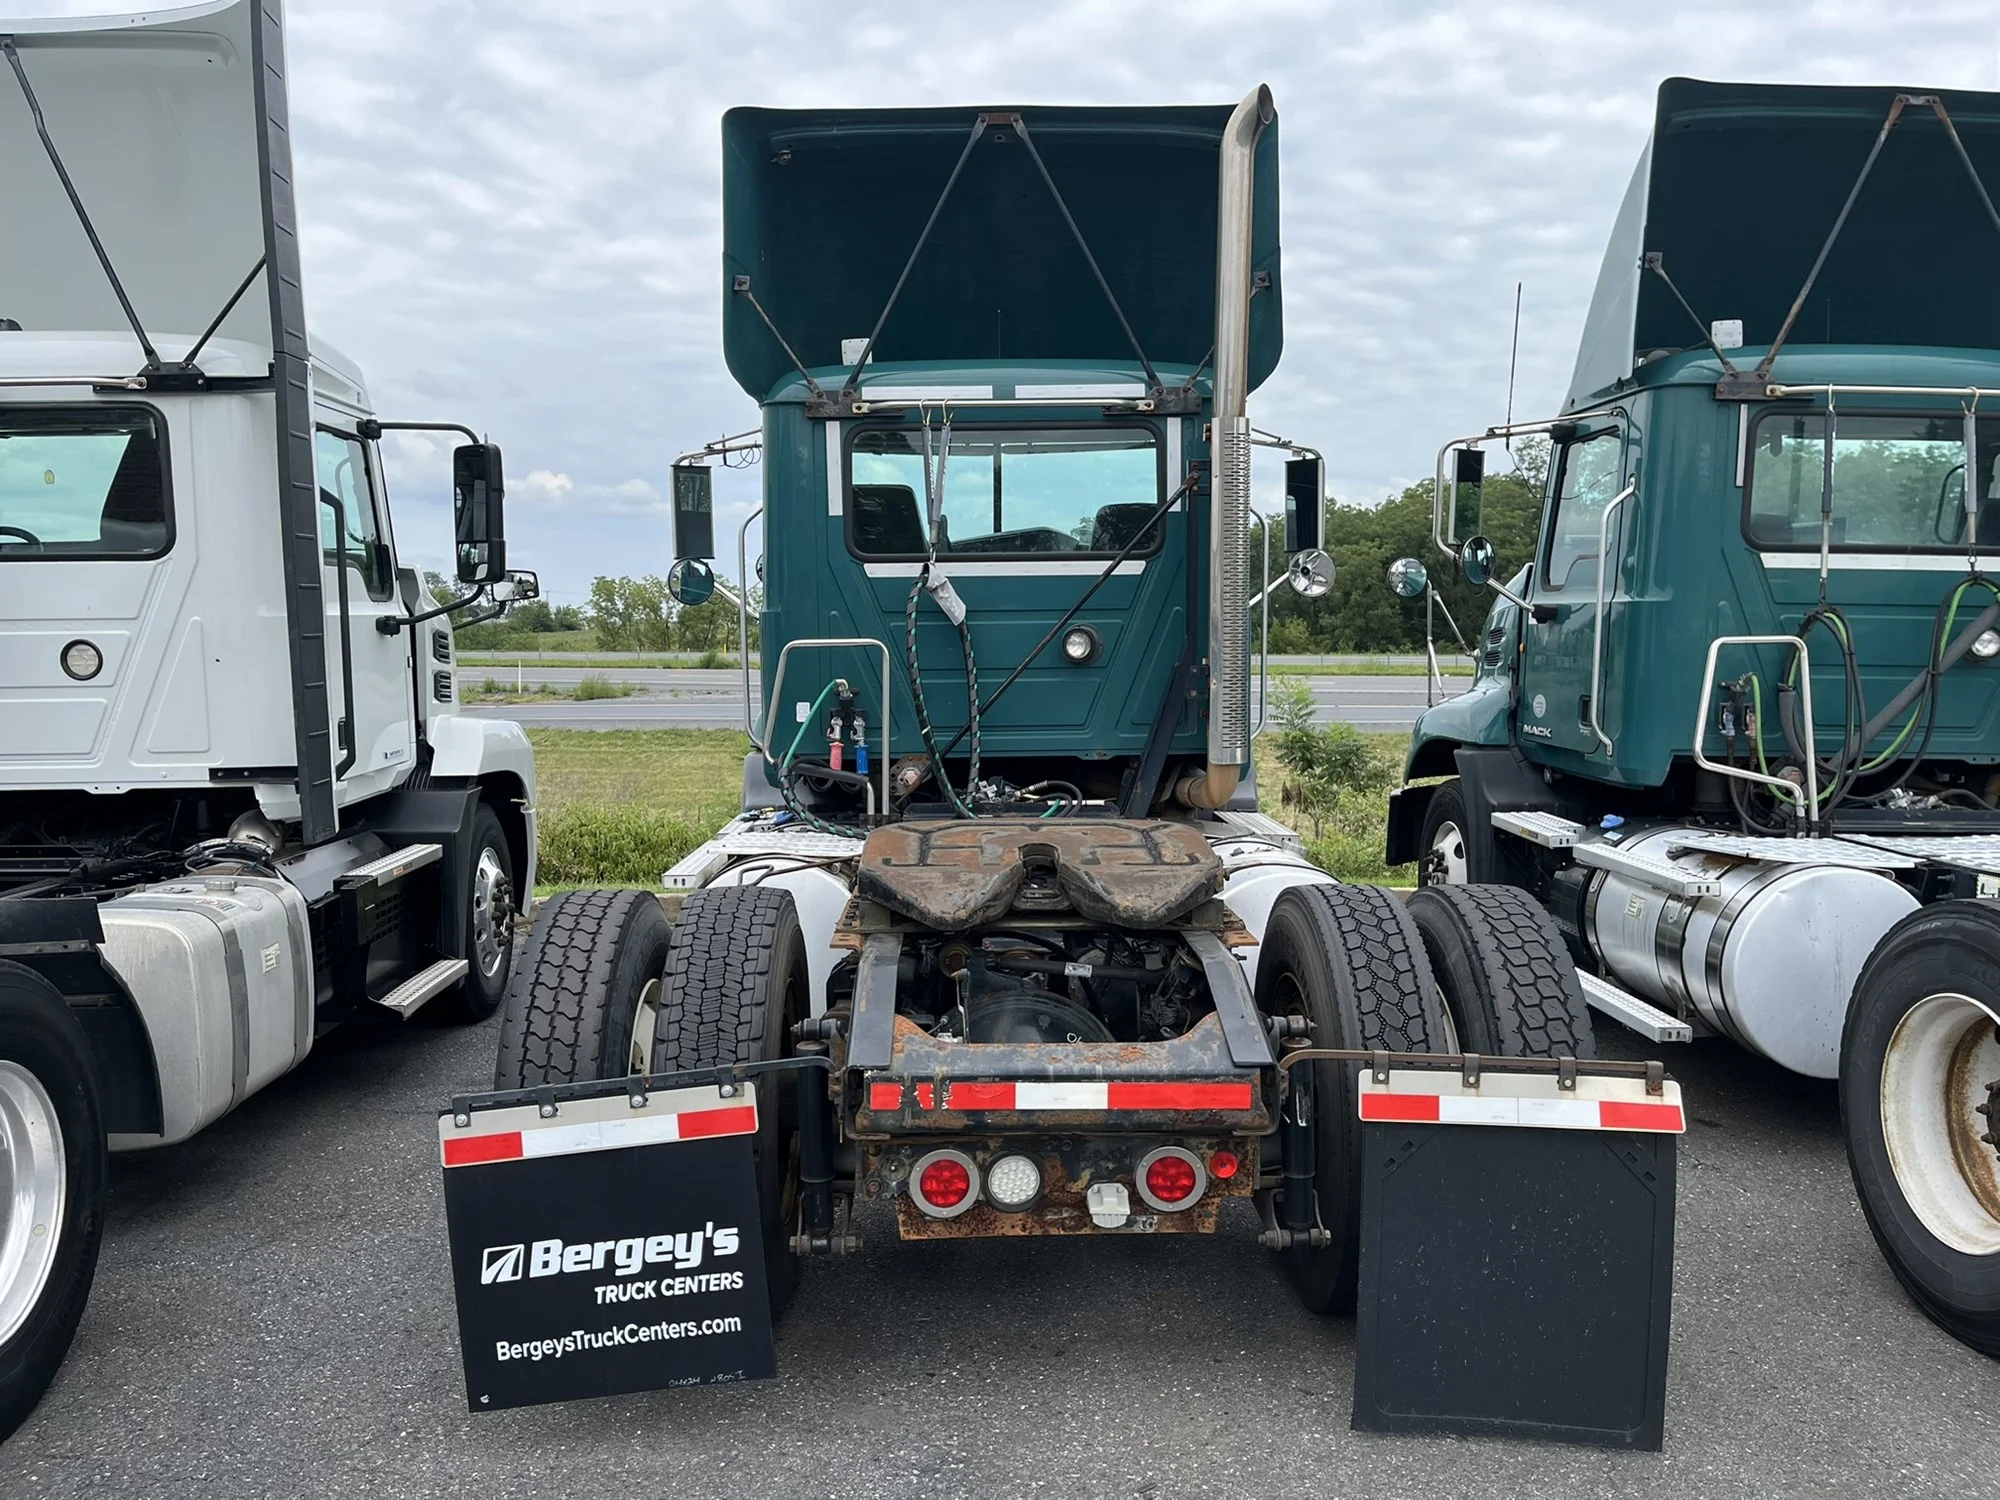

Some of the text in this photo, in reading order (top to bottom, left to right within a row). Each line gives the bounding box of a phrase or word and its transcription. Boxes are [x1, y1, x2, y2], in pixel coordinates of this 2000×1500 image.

[1523, 724, 1552, 737] MACK
[529, 1221, 740, 1278] Bergey's
[594, 1271, 744, 1305] TRUCK CENTERS
[496, 1316, 742, 1361] BergeysTruckCenters.com
